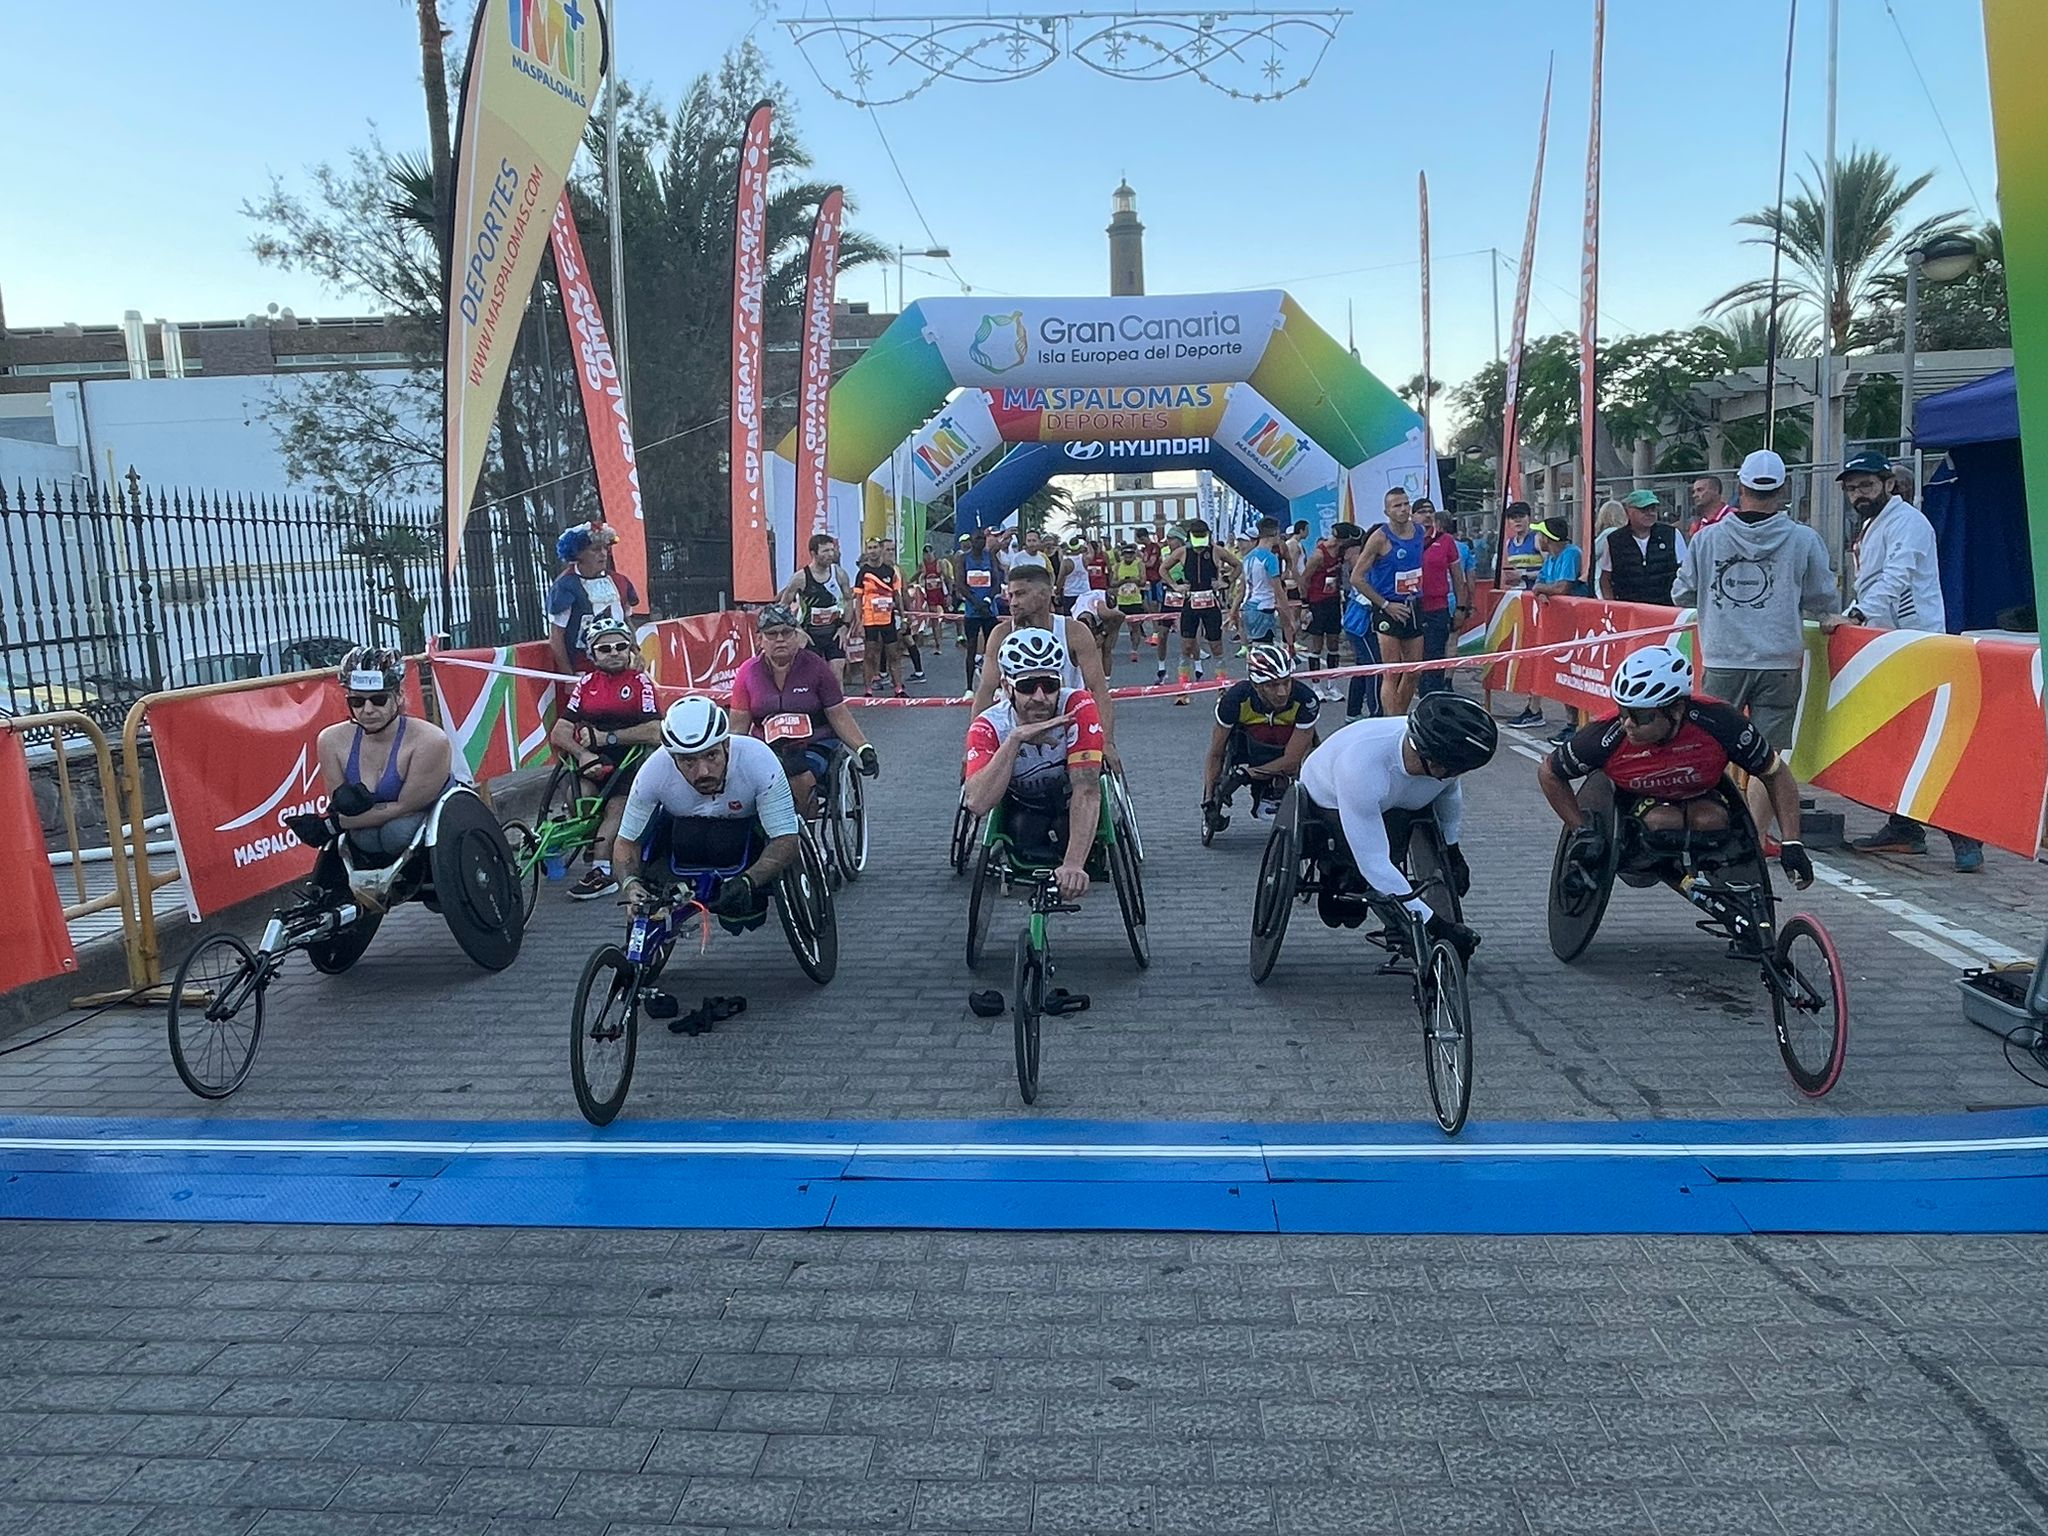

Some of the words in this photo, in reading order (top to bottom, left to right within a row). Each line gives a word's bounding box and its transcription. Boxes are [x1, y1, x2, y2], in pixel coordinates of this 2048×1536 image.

[512, 54, 586, 108] MASPALOMAS
[460, 157, 519, 327] DEPORTES
[469, 164, 544, 387] WWW.MASPALOMAS.COM
[1040, 317, 1115, 344] Gran
[1119, 311, 1241, 341] Canaria
[1038, 350, 1065, 364] Isla
[1071, 348, 1139, 364] Europea
[1144, 345, 1170, 360] del
[1175, 341, 1242, 360] Deporte
[806, 383, 818, 450] GRAN
[1003, 384, 1213, 411] MASPALOMAS
[1047, 412, 1168, 430] DEPORTES
[935, 445, 982, 487] MASPALOMAS
[1109, 437, 1210, 457] HYUNDAI
[1235, 441, 1285, 482] MASPALOMAS
[233, 828, 302, 868] MASPALO
